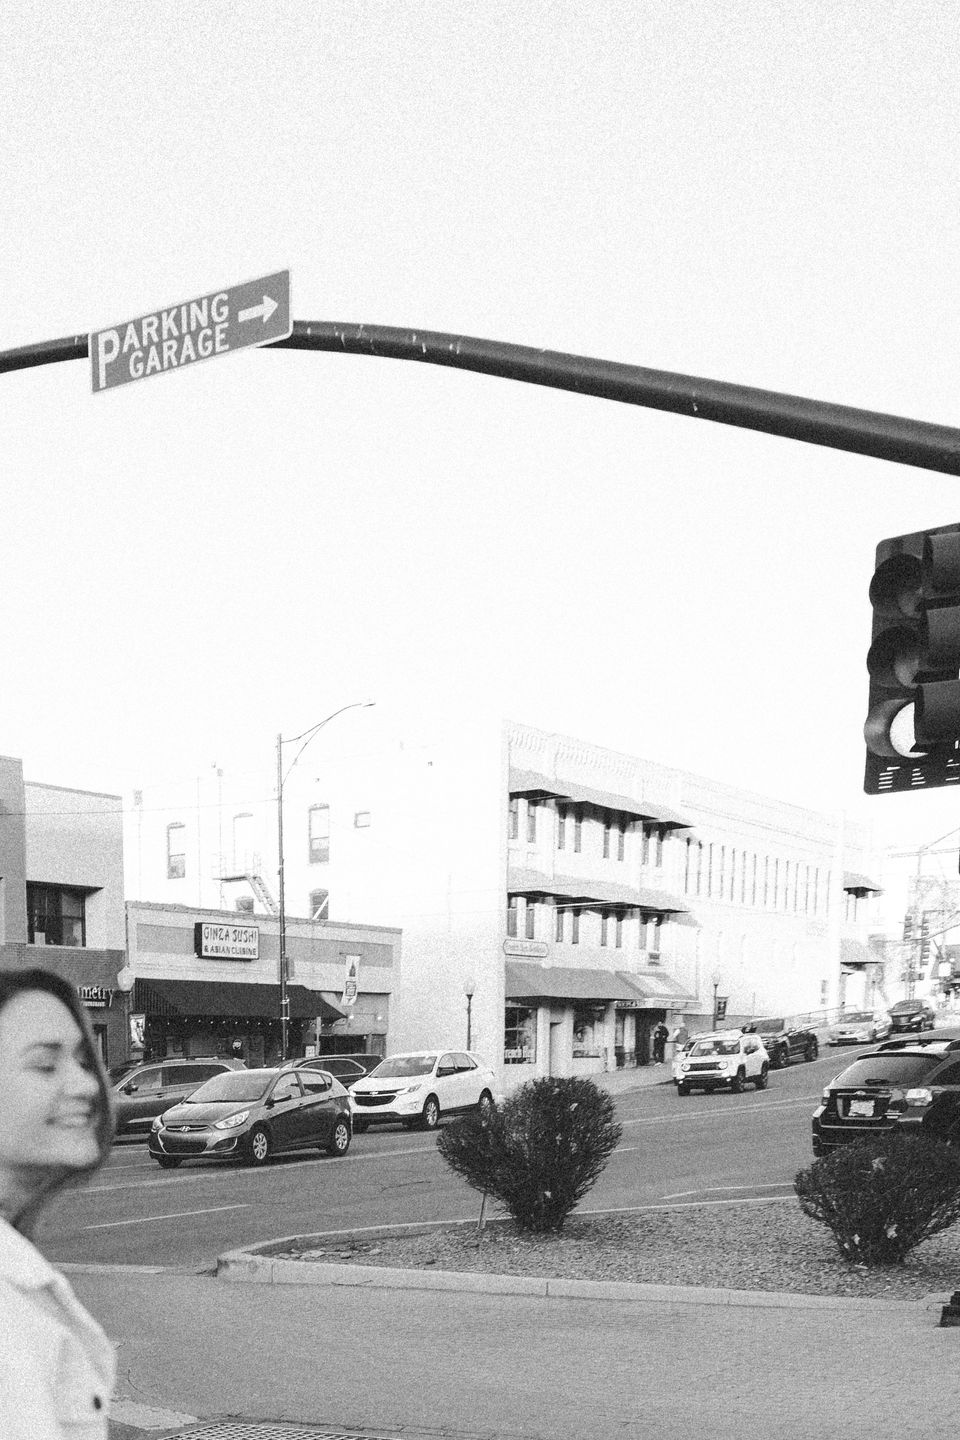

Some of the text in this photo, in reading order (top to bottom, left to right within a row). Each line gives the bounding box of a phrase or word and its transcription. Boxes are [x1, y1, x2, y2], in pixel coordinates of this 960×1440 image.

[97, 292, 229, 390] PARKING
[128, 321, 230, 378] GARAGE
[203, 926, 257, 943] GINZA SUSHI
[76, 986, 115, 1008] metry
